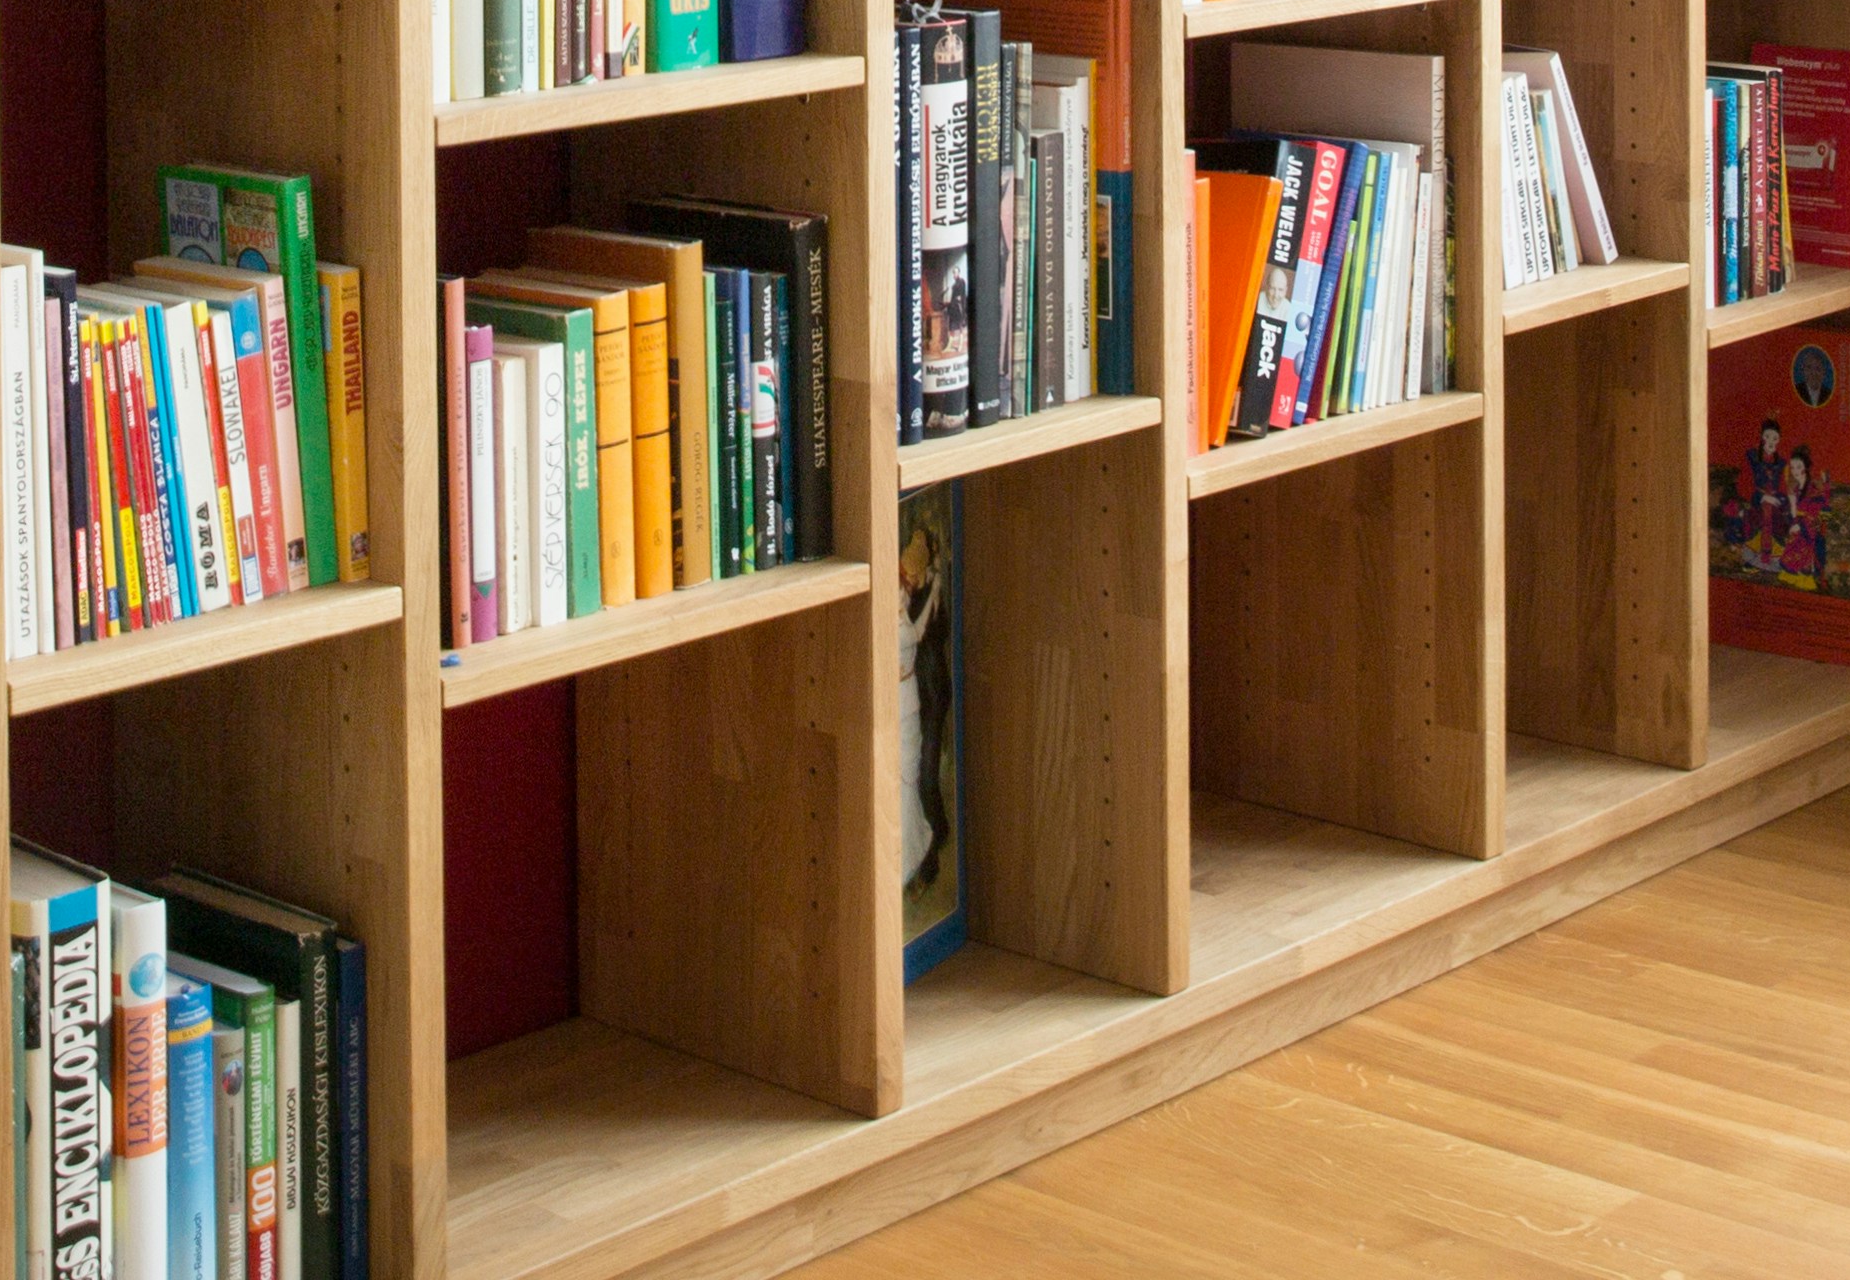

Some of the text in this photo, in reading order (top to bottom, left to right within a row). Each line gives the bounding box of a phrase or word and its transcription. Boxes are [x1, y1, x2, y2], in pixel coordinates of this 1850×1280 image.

[931, 122, 949, 228] A magyarok
[947, 99, 970, 228] krónikája
[1273, 154, 1303, 264] JACK WELCH
[1309, 148, 1338, 226] GOAL
[1043, 155, 1055, 345] LEONARDO DA VINCI
[268, 316, 292, 411] UNGARN
[342, 309, 365, 416] THAILAND
[1256, 318, 1283, 379] jack
[219, 365, 247, 467] SLOWAKEI
[149, 416, 175, 557] COSTA BLANCA
[18, 553, 31, 638] UTAZÁSOK
[196, 501, 219, 592] ROMA
[127, 1014, 150, 1148] LEXIKON
